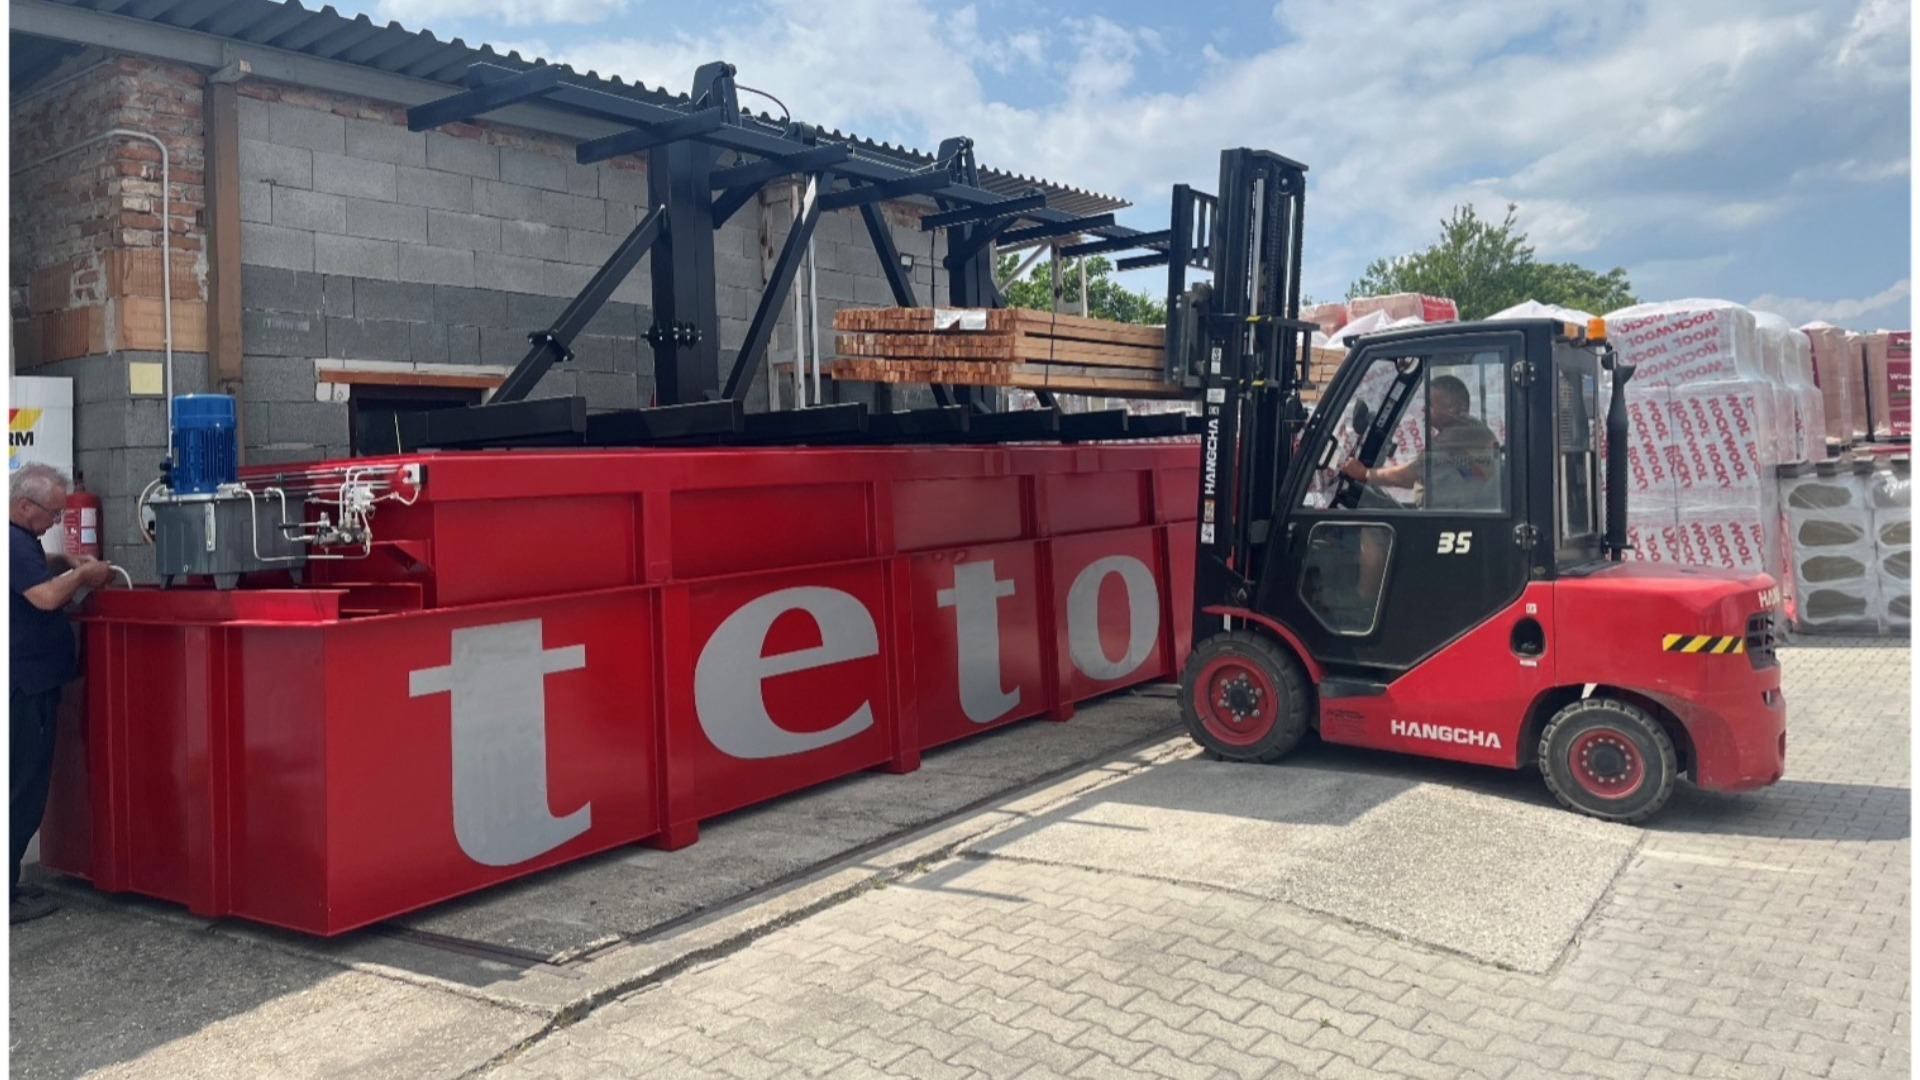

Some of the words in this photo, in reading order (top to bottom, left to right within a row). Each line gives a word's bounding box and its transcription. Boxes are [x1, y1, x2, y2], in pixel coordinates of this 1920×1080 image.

[1627, 311, 1716, 347] ROCKWOOL
[1204, 418, 1219, 495] HANGCHA
[1707, 397, 1748, 481] ROCKWOOL
[1436, 531, 1473, 554] 35
[1646, 534, 1661, 562] OOL
[408, 554, 1160, 867] teto
[1391, 719, 1502, 749] HANGCHA
